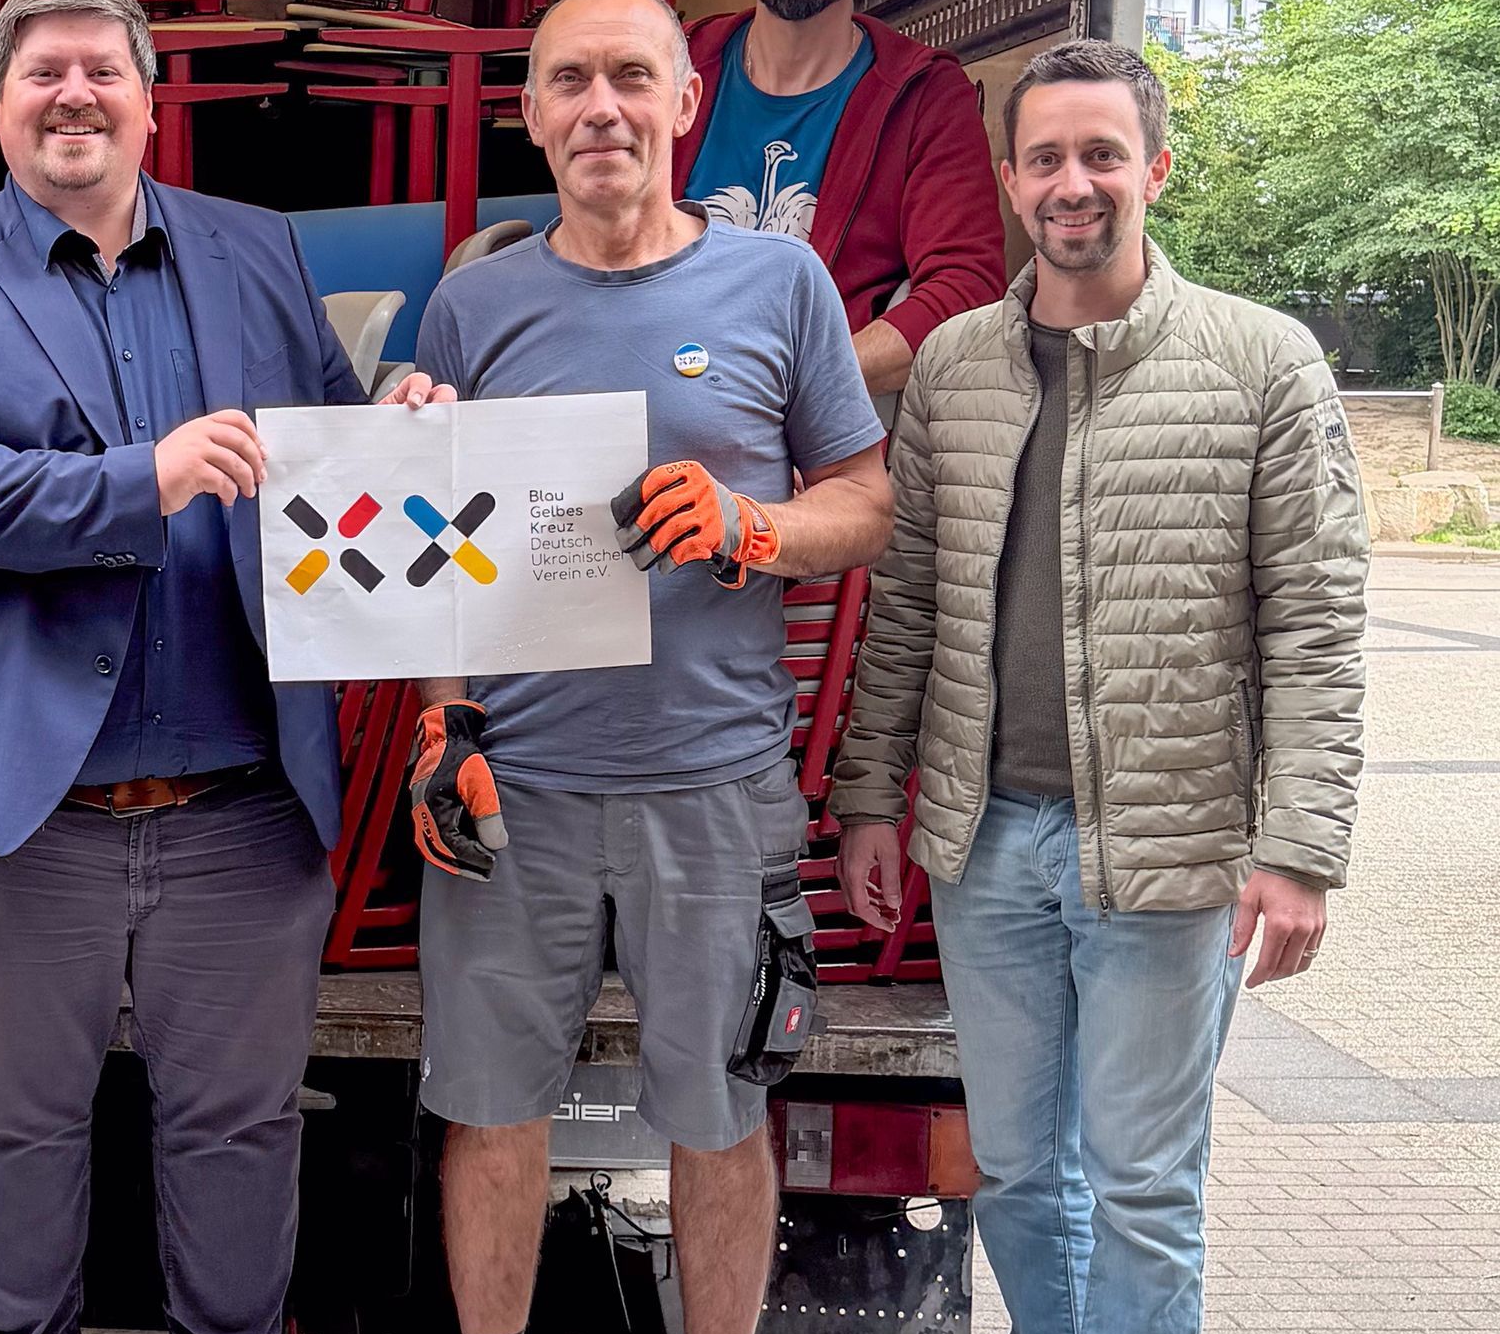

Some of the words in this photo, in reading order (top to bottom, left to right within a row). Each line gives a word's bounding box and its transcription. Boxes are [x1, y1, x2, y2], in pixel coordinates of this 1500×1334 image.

[529, 489, 564, 503] Blau
[530, 505, 583, 518] Gelbes
[530, 521, 575, 534] Kreuz
[531, 534, 593, 550] Deutsch
[531, 548, 625, 567] Ukrainischer
[532, 567, 581, 581] Verein
[586, 564, 611, 579] e.V.
